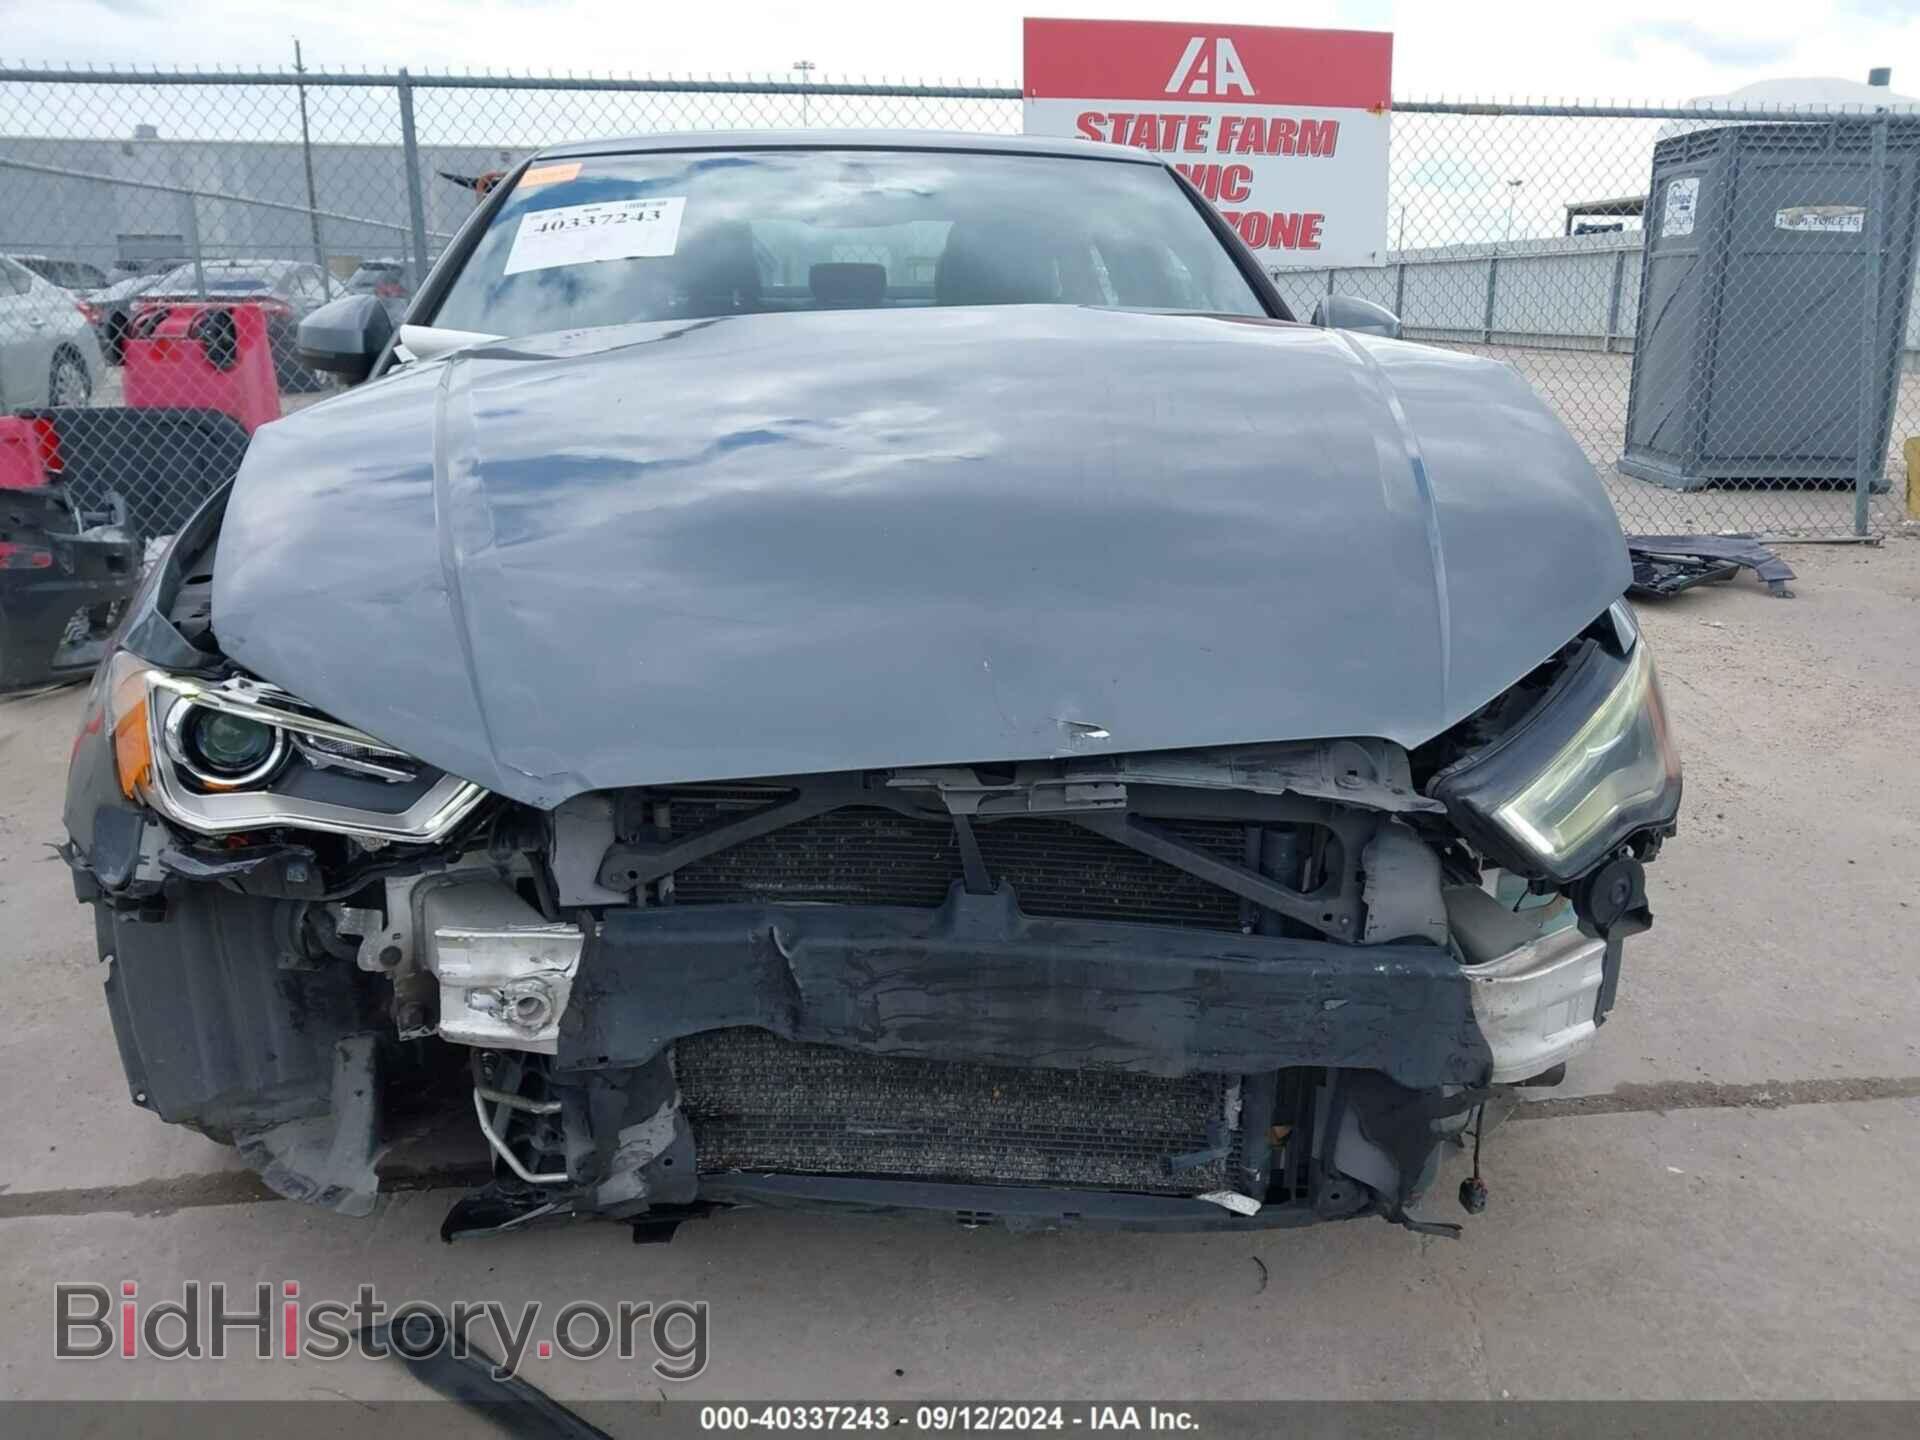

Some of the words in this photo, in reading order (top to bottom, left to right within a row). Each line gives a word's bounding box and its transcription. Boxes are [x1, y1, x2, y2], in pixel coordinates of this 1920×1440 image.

[1075, 111, 1211, 153] STATE
[1216, 115, 1341, 159] FARM
[533, 209, 661, 233] 40337243
